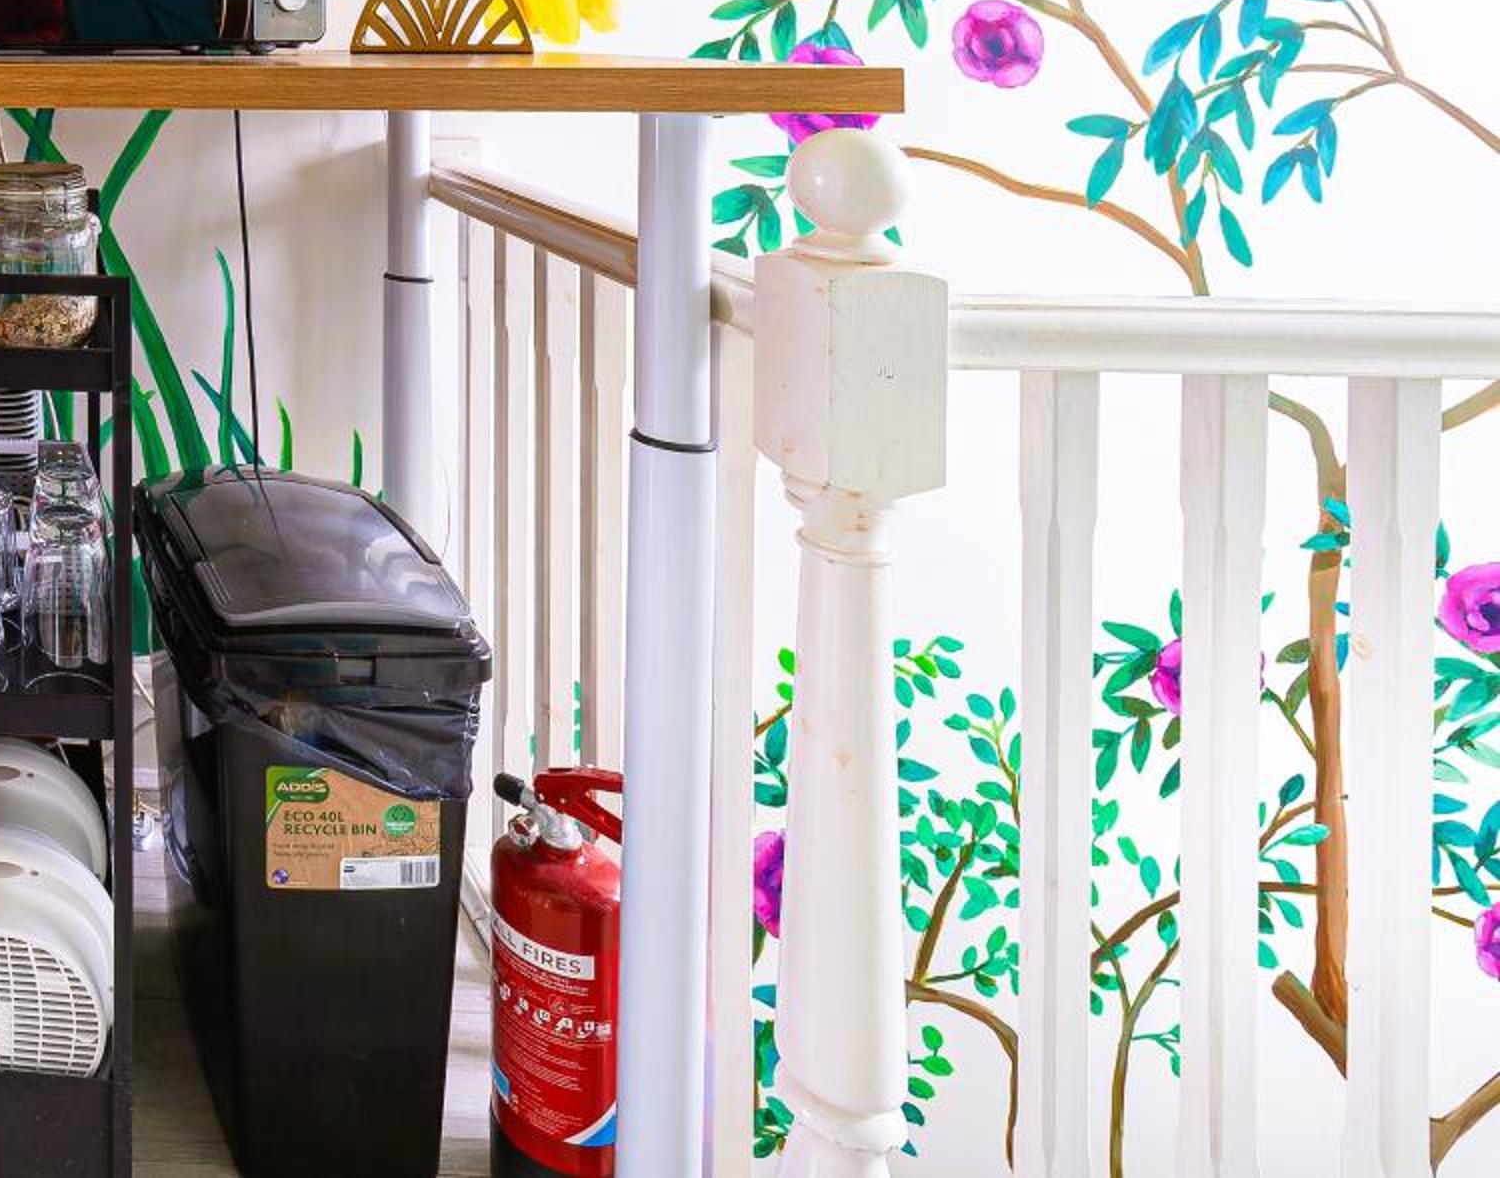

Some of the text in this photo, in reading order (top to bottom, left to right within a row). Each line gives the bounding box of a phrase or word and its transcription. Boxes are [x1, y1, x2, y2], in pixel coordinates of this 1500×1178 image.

[283, 810, 345, 823] ECO 40L
[283, 823, 347, 836] RECYCLE
[351, 823, 377, 836] BIN
[522, 941, 582, 975] FIRES
